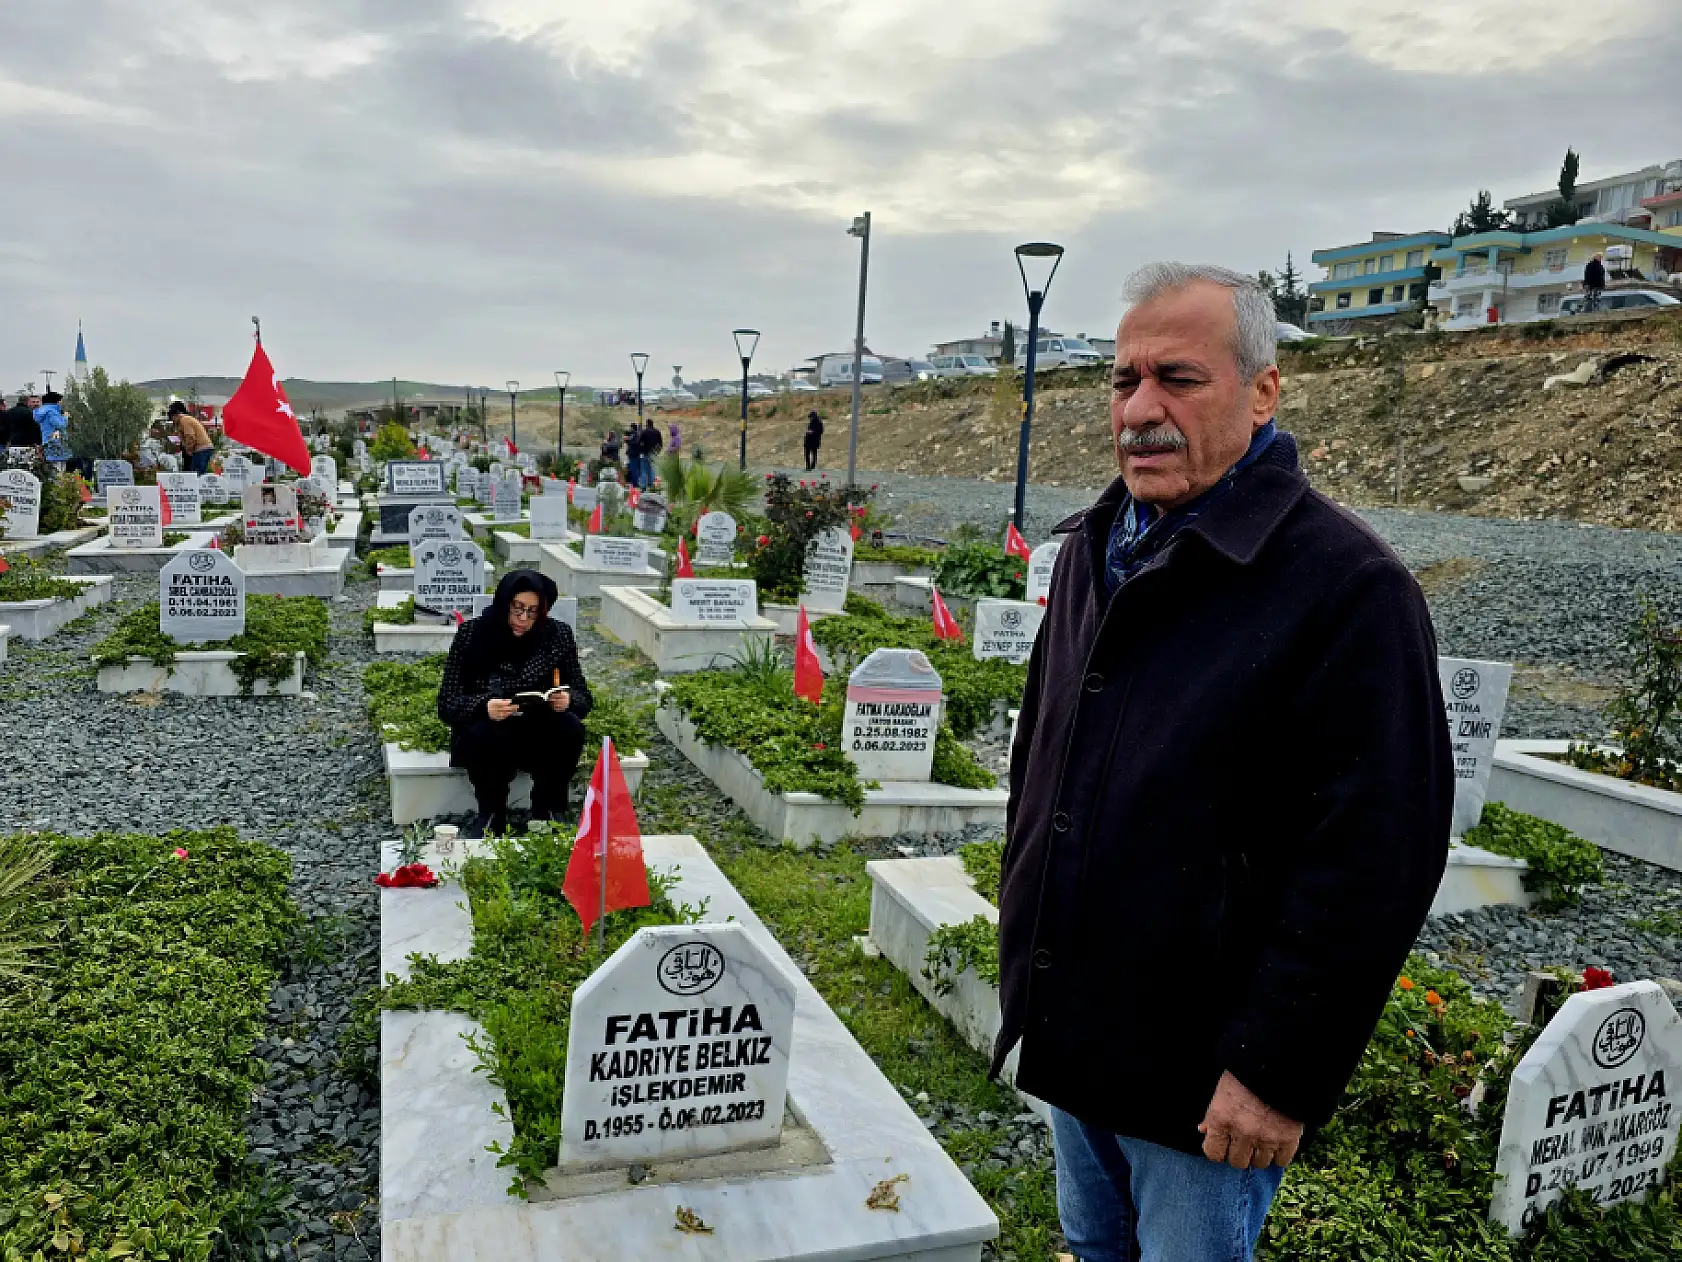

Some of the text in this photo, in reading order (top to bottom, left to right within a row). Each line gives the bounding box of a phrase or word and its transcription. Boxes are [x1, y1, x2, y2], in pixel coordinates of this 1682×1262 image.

[1445, 701, 1480, 713] ATİHA
[852, 739, 927, 751] Ö.06.02.2023
[695, 1036, 772, 1071] BELKIZ
[584, 1115, 645, 1141] D.1955
[1530, 1130, 1576, 1168] MERAL
